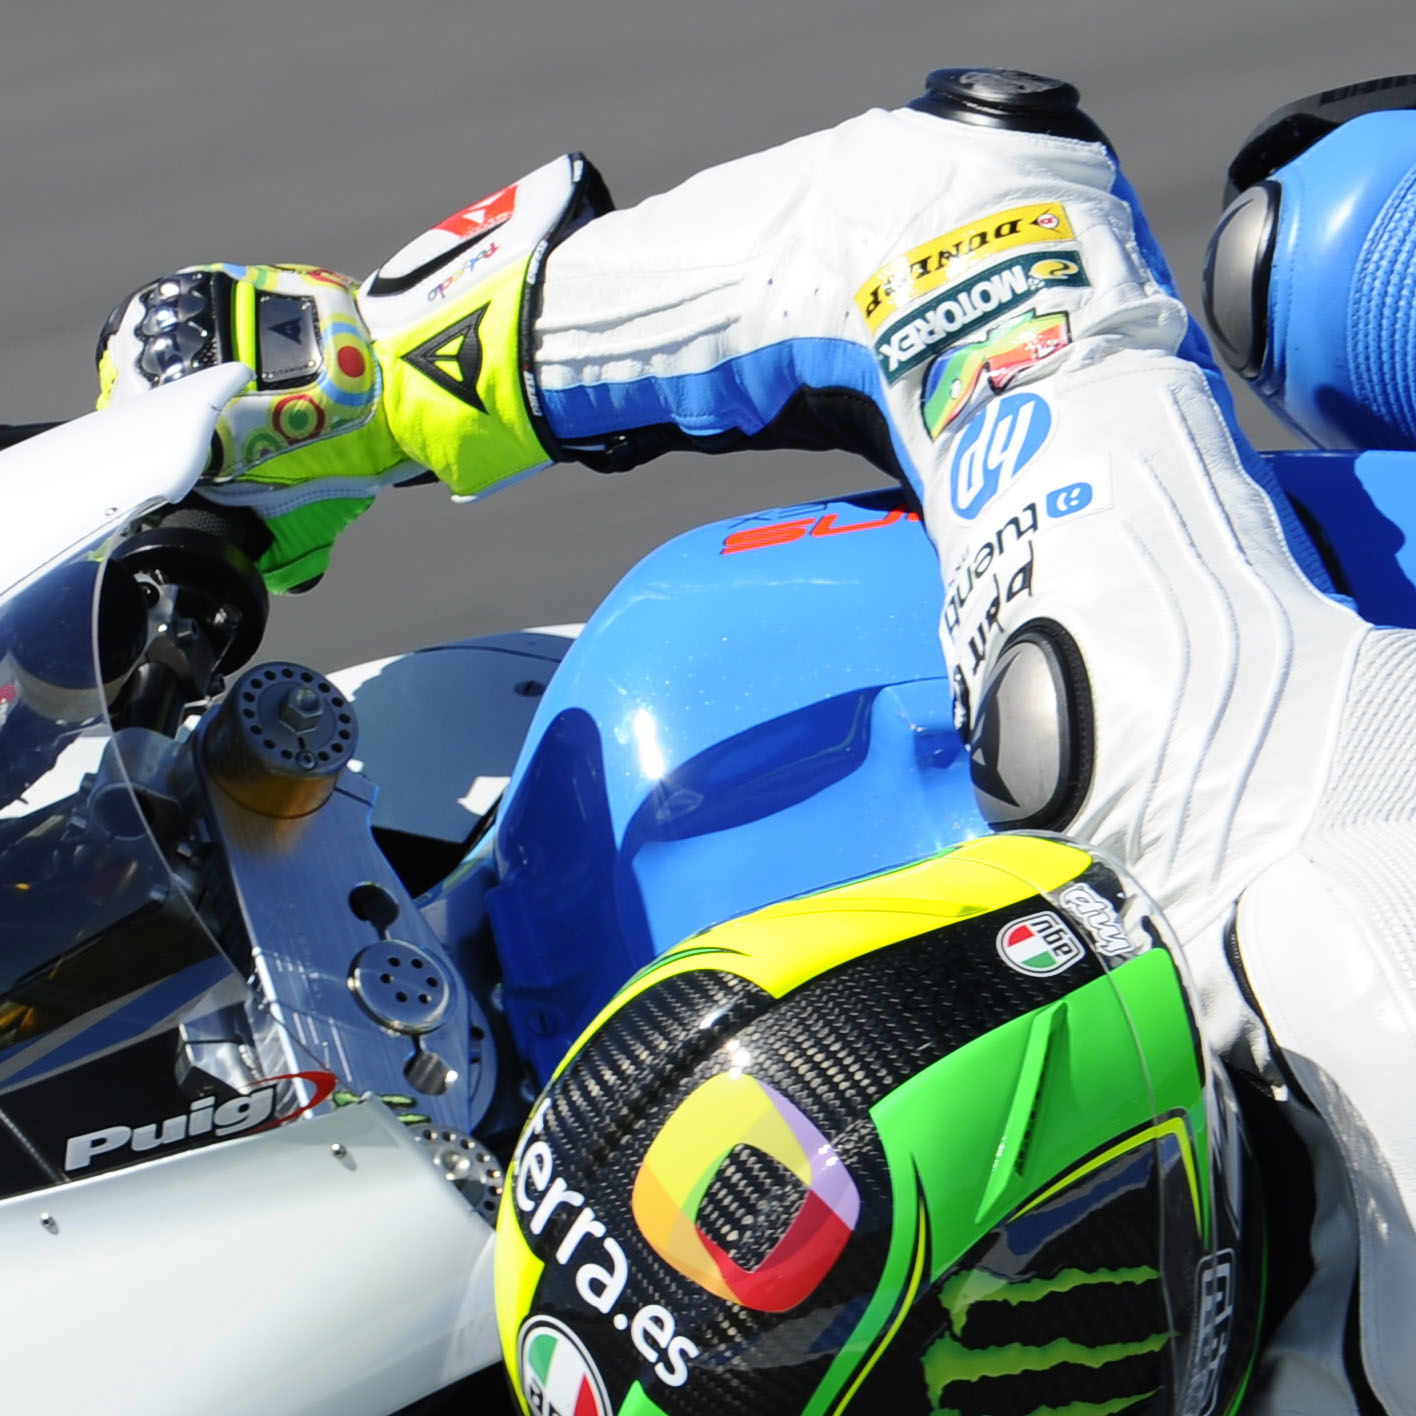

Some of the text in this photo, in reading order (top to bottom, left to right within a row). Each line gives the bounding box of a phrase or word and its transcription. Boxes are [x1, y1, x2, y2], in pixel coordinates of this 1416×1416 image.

[877, 264, 1030, 373] MOTOREX
[1031, 919, 1074, 957] agv
[63, 1087, 281, 1173] Puig
